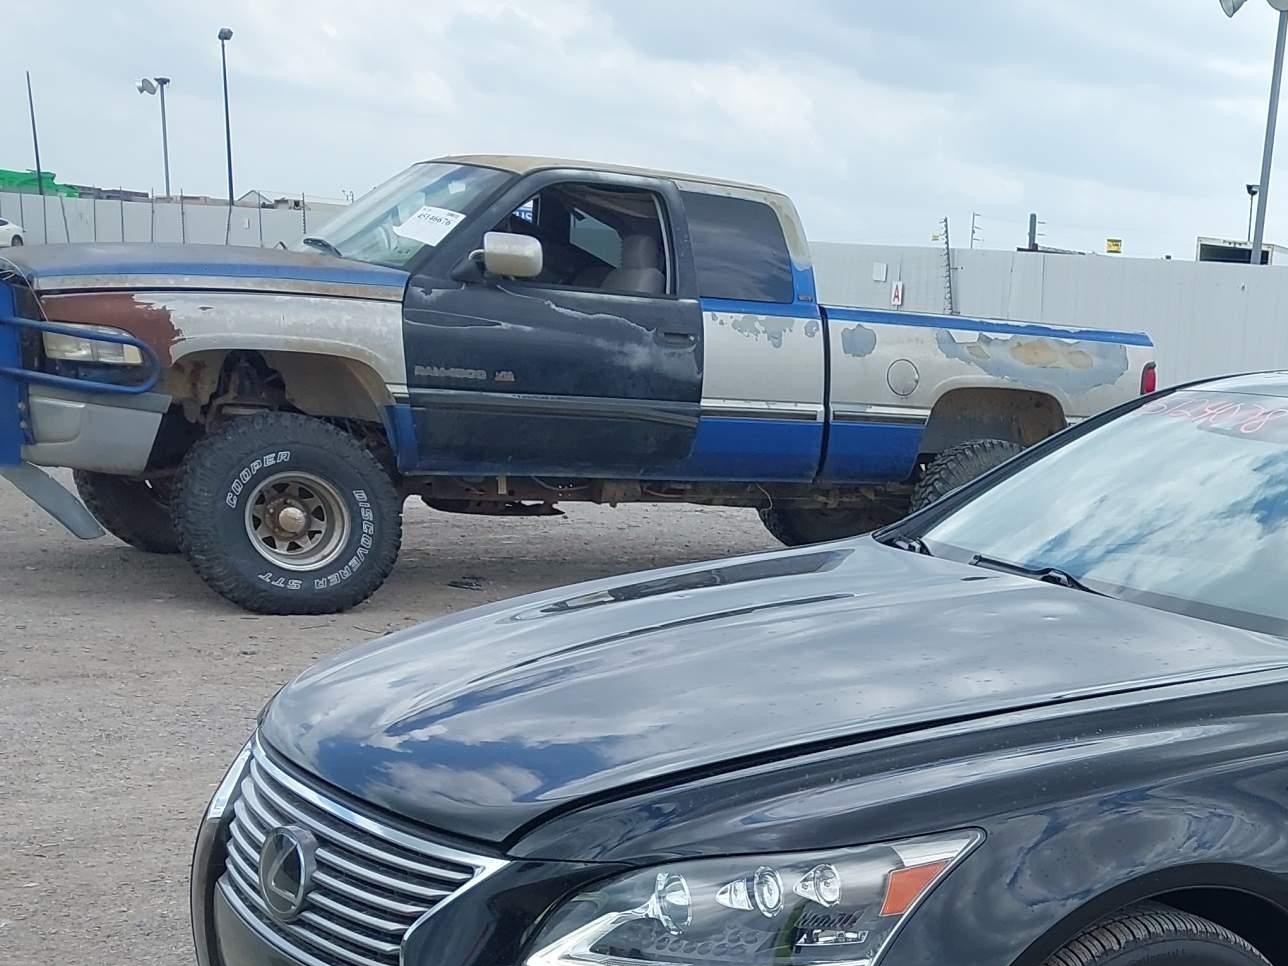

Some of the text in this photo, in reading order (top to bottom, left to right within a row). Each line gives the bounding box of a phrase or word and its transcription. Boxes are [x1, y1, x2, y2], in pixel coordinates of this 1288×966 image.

[892, 284, 901, 302] A
[226, 450, 291, 509] COOPER
[257, 489, 375, 591] DISCOVERER STT
